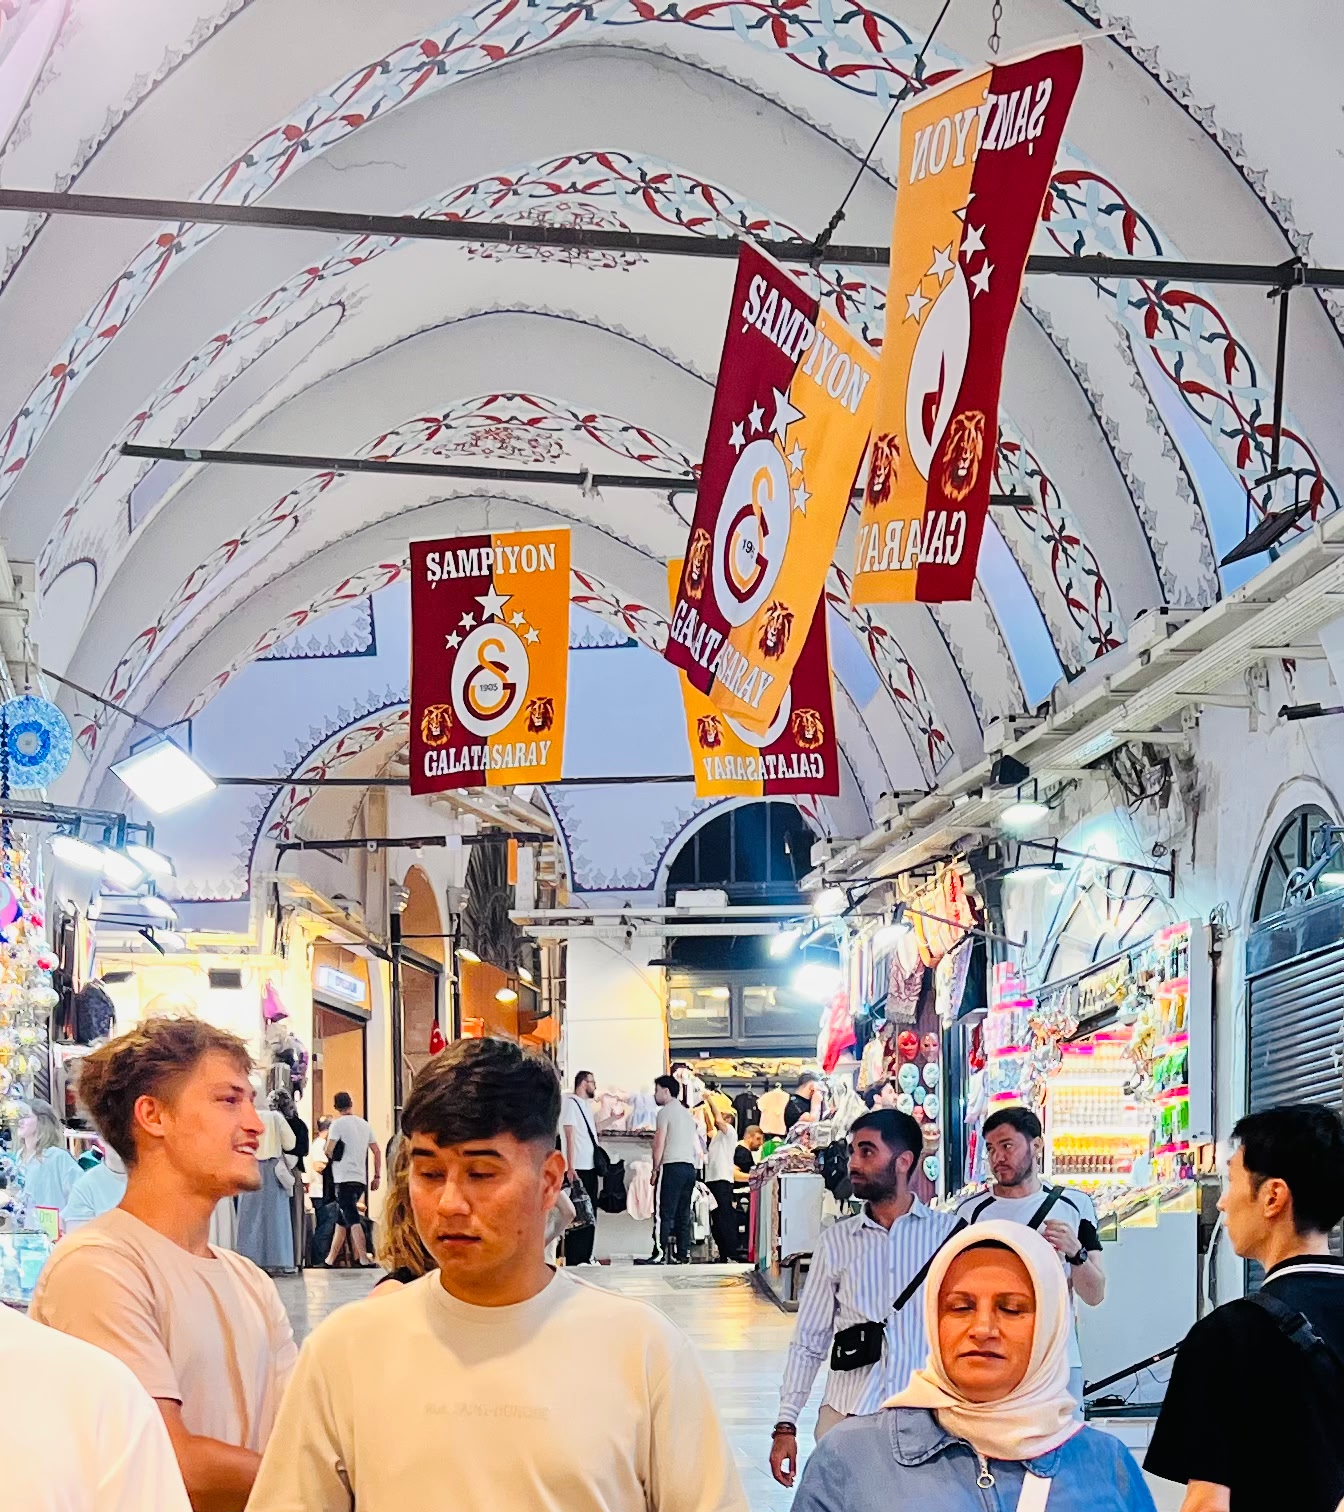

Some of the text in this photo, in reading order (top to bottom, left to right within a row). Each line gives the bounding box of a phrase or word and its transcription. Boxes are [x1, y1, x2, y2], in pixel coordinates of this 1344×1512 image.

[741, 273, 871, 415] ŞAMPİYON
[425, 540, 557, 590] ŞAMPİYON
[670, 598, 775, 709] GAATASARAY
[424, 739, 554, 778] GALATASARAY
